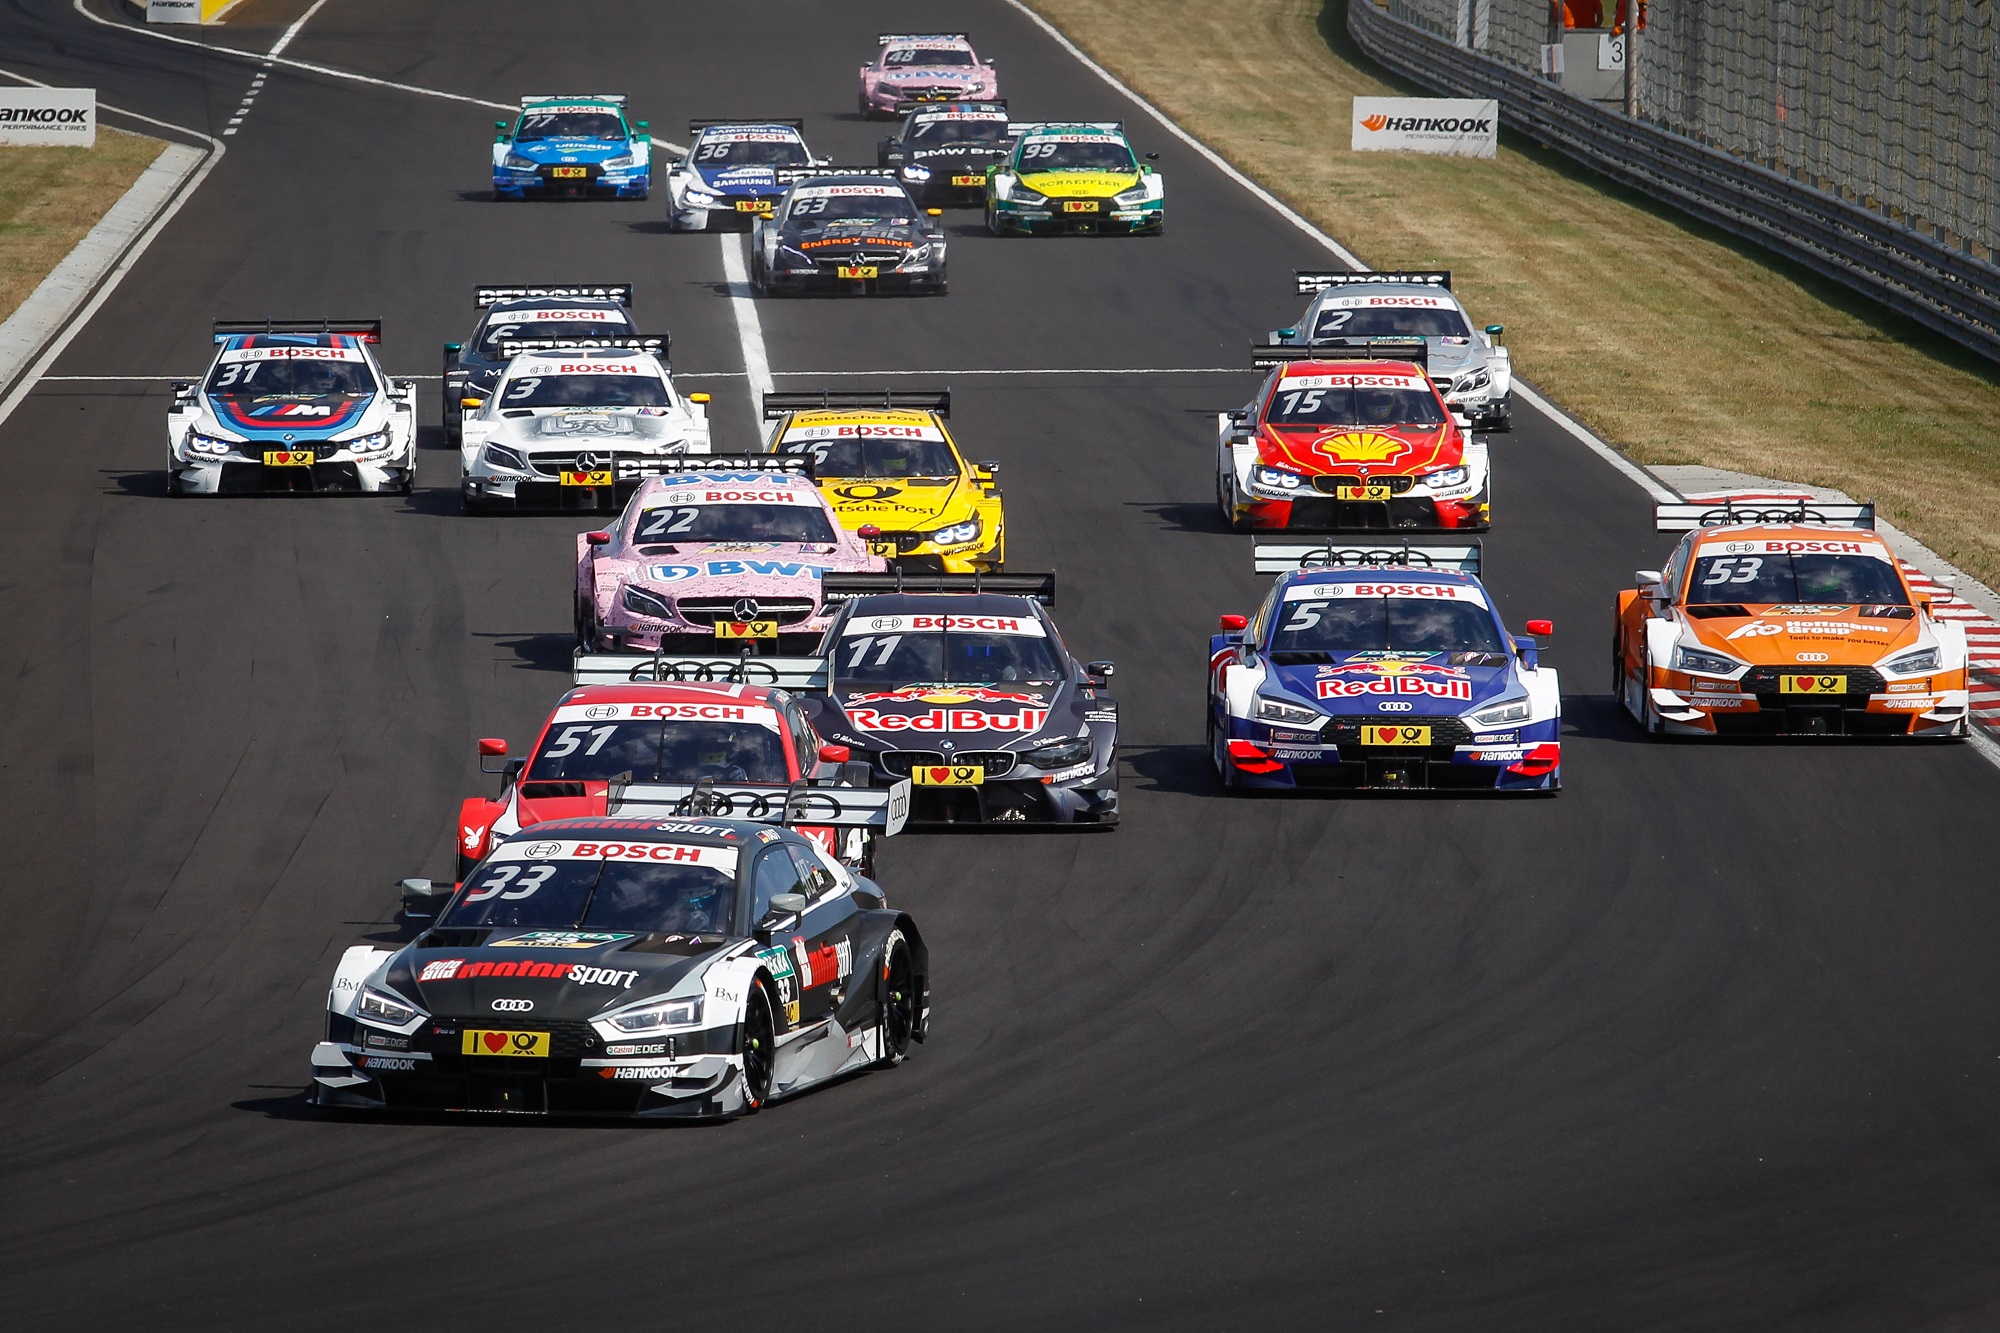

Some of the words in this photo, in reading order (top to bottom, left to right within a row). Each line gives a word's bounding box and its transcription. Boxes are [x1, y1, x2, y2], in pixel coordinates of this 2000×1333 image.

[888, 51, 916, 62] 48
[1611, 41, 1623, 63] 3
[915, 71, 972, 81] BWT
[524, 115, 557, 130] 77
[914, 122, 935, 138] 7
[1405, 133, 1464, 141] PERFORMANCE
[697, 143, 731, 161] 36
[913, 148, 966, 160] BMW
[970, 148, 1012, 156] Ban
[1023, 144, 1057, 159] 99
[713, 178, 772, 188] SAMSUNG
[1039, 179, 1121, 188] SCHAEFFLER
[792, 199, 829, 216] 63
[801, 237, 862, 250] ENERGY
[866, 237, 914, 248] DRINK
[1369, 297, 1438, 306] BOSCH
[537, 311, 606, 320] BOSCH
[1319, 311, 1353, 331] 2
[487, 325, 521, 345] 6
[269, 349, 345, 359] BOSCH
[216, 362, 262, 387] 31
[560, 364, 637, 374] BOSCH
[1331, 376, 1410, 387] BOSCH
[507, 378, 543, 400] 3
[1282, 390, 1327, 415] 15
[800, 415, 883, 424] Deutsche
[887, 415, 925, 423] Post
[838, 426, 922, 437] BOSCH
[787, 441, 834, 465] 16
[705, 491, 794, 502] BOSCH
[893, 504, 936, 515] Post
[641, 507, 700, 536] 22
[1766, 541, 1861, 553] BOSCH
[705, 560, 834, 580] BWT
[1703, 557, 1764, 585] 53
[1355, 585, 1456, 598] BOSCH
[1283, 601, 1329, 632] 5
[912, 617, 1019, 631] BOSCH
[1785, 620, 1889, 633] Hoffmann
[1787, 627, 1851, 636] Group
[1863, 638, 1889, 647] better
[847, 635, 903, 668] 11
[1318, 676, 1392, 699] Red
[1399, 677, 1470, 699] Bull
[1714, 683, 1737, 691] EDGE
[1907, 682, 1926, 690] EDGE
[631, 705, 744, 719] BOSCH
[845, 709, 943, 731] Red
[951, 709, 1049, 731] Bull
[544, 725, 619, 758] 51
[1293, 732, 1317, 742] EDGE
[1494, 733, 1515, 742] EDGE
[571, 843, 702, 862] BOSCH
[464, 865, 557, 902] 33
[535, 931, 616, 941] DEKRA
[424, 959, 463, 972] Auto
[420, 969, 457, 981] Bild
[335, 977, 360, 992] BM
[777, 977, 791, 1004] 33
[714, 987, 739, 1003] BM
[384, 1037, 409, 1048] EDGE
[613, 1045, 634, 1054] Castrol
[634, 1044, 666, 1054] EDGE
